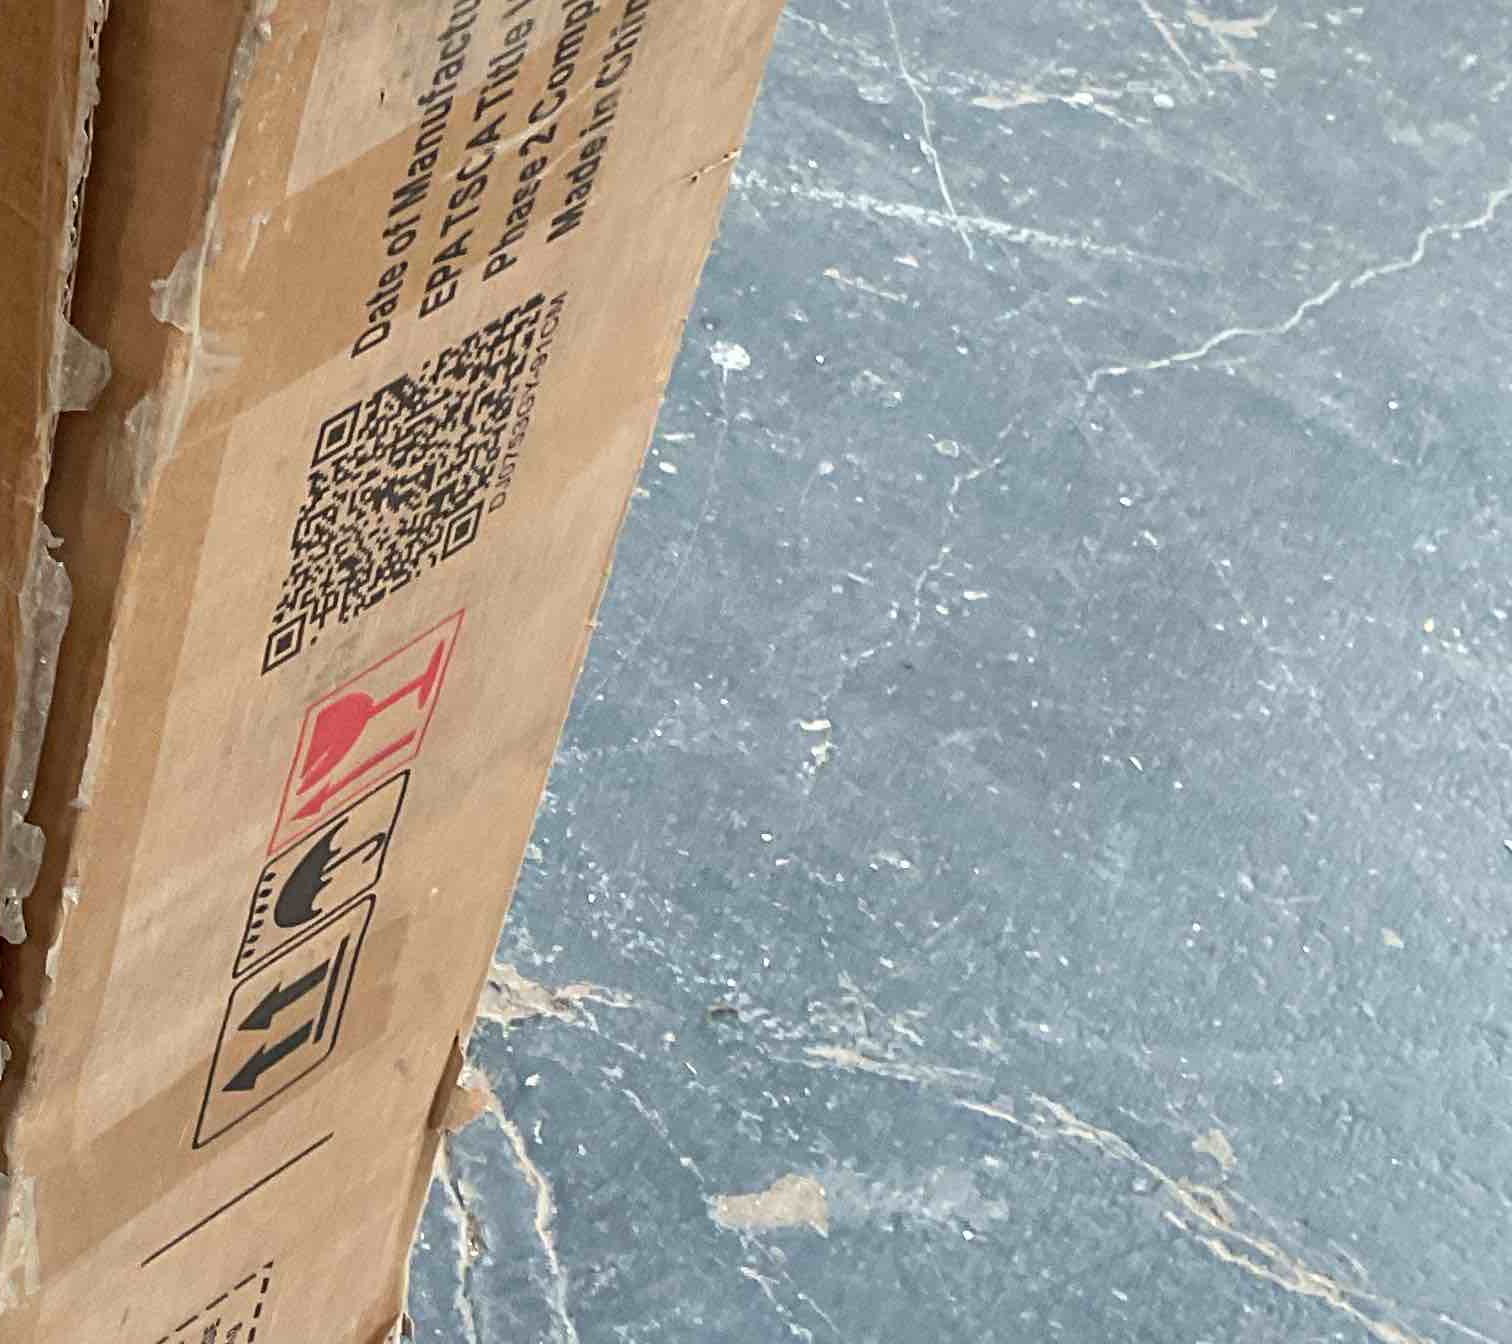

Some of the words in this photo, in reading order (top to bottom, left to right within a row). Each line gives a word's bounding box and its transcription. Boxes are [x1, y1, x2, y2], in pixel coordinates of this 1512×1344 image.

[472, 18, 536, 120] Title
[440, 112, 507, 241] TSCA
[482, 154, 549, 282] Phase
[518, 122, 559, 162] 2
[546, 132, 609, 244] Made
[581, 84, 623, 141] in
[351, 258, 410, 358] Date
[382, 207, 422, 256] of
[419, 226, 472, 318] EPA
[488, 290, 569, 515] DJ0753GY-91CM
